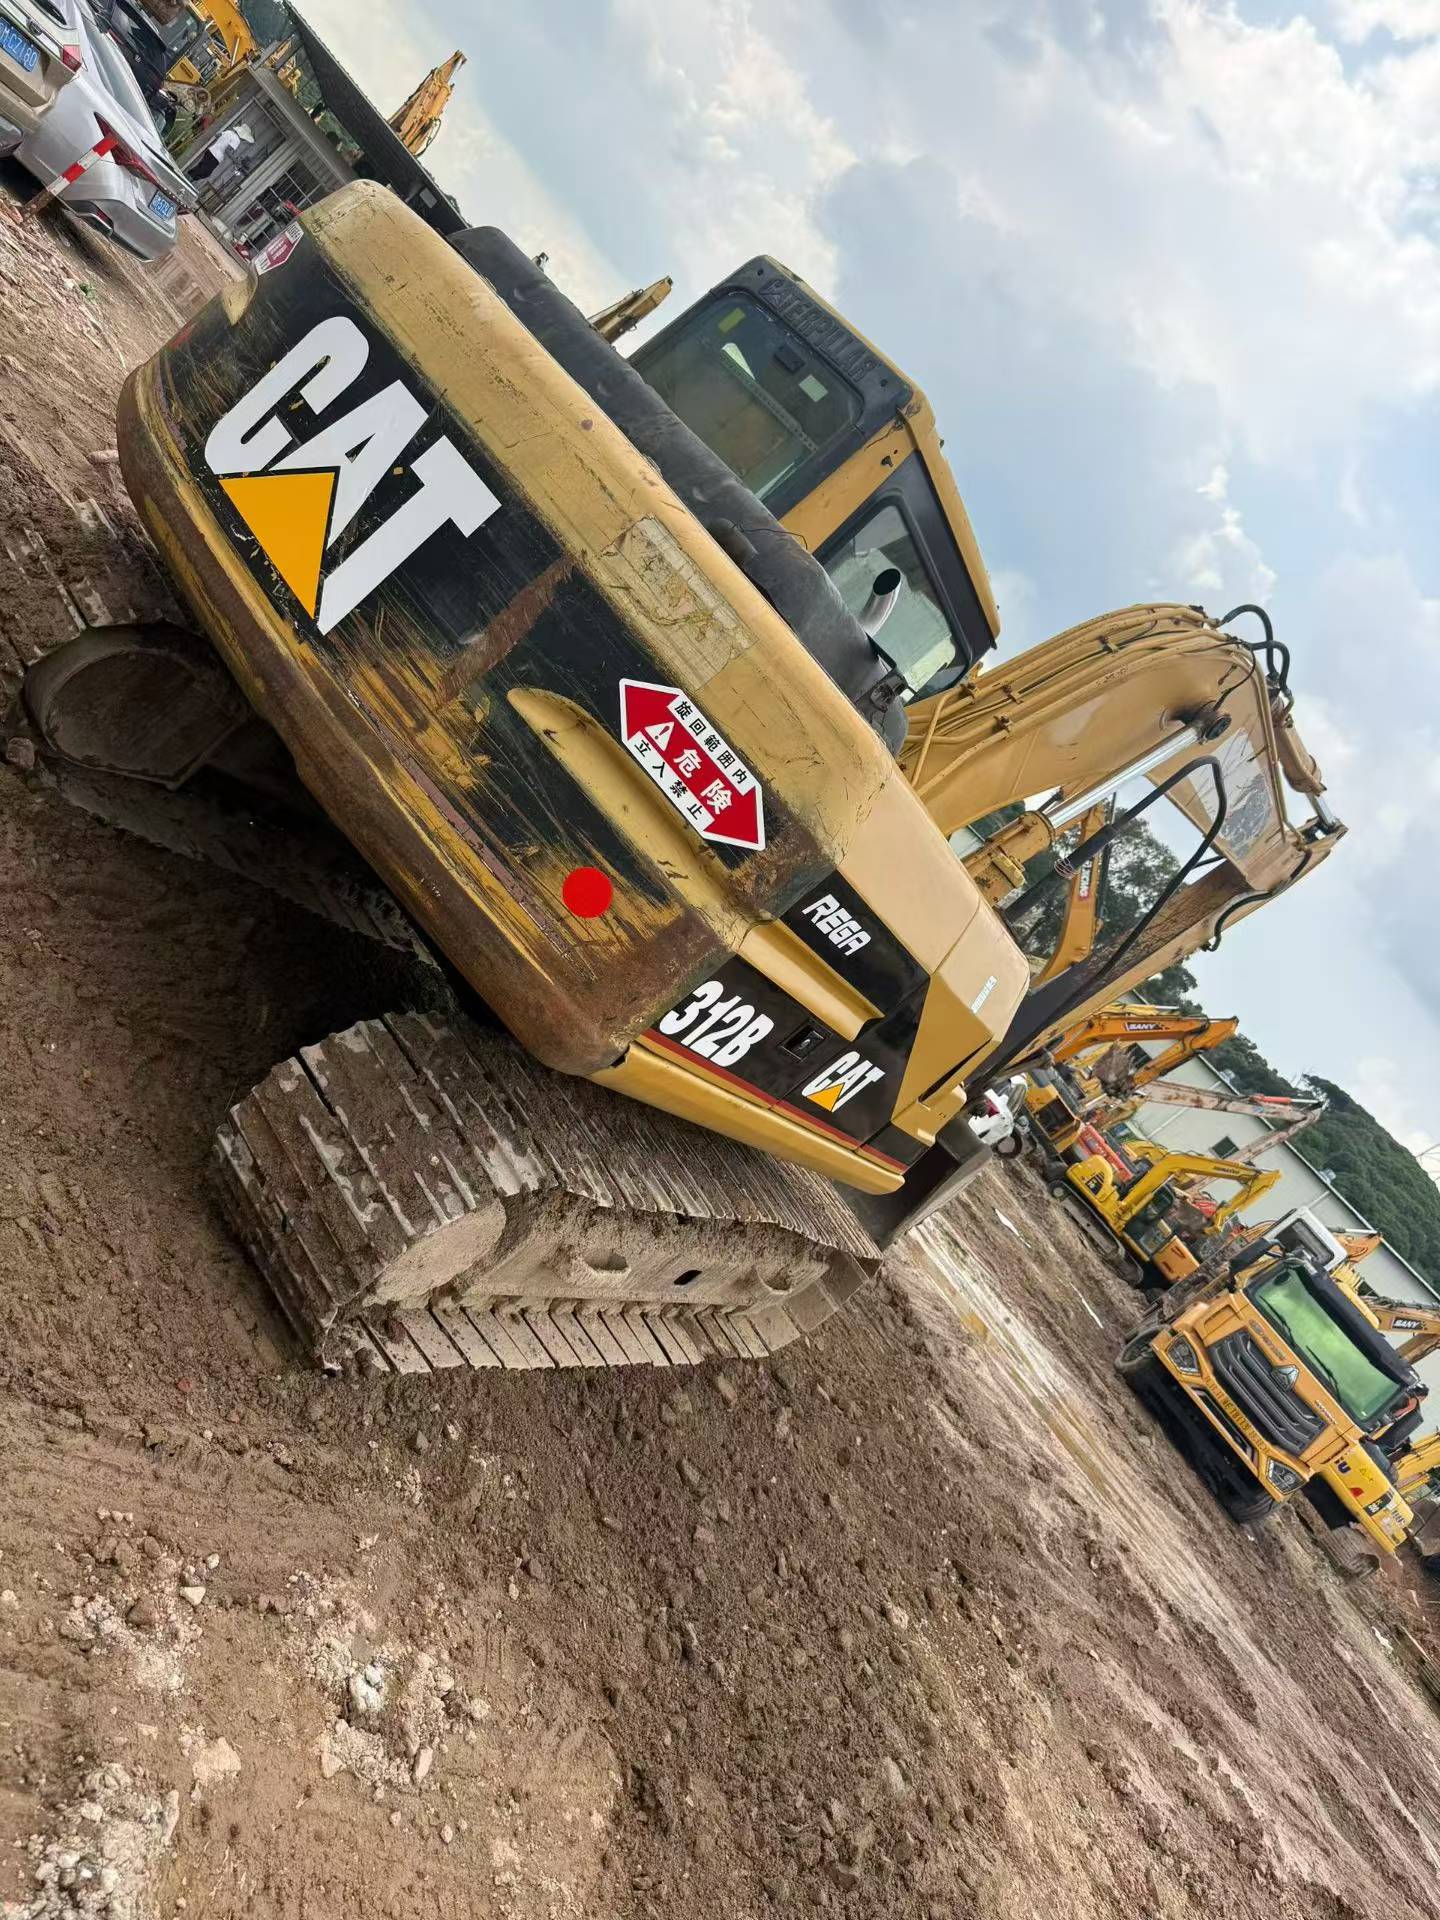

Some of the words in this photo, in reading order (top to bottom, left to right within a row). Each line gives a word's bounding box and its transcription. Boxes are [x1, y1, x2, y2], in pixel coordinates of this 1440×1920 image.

[204, 316, 502, 636] CAT
[674, 701, 748, 784] 旋回範囲内
[634, 739, 703, 820] 立入禁止
[673, 748, 732, 815] 危険
[802, 893, 872, 956] REGA
[659, 980, 774, 1067] 312B
[1127, 1022, 1156, 1031] SANY
[801, 1051, 886, 1112] CAT
[1393, 1318, 1421, 1329] SANY
